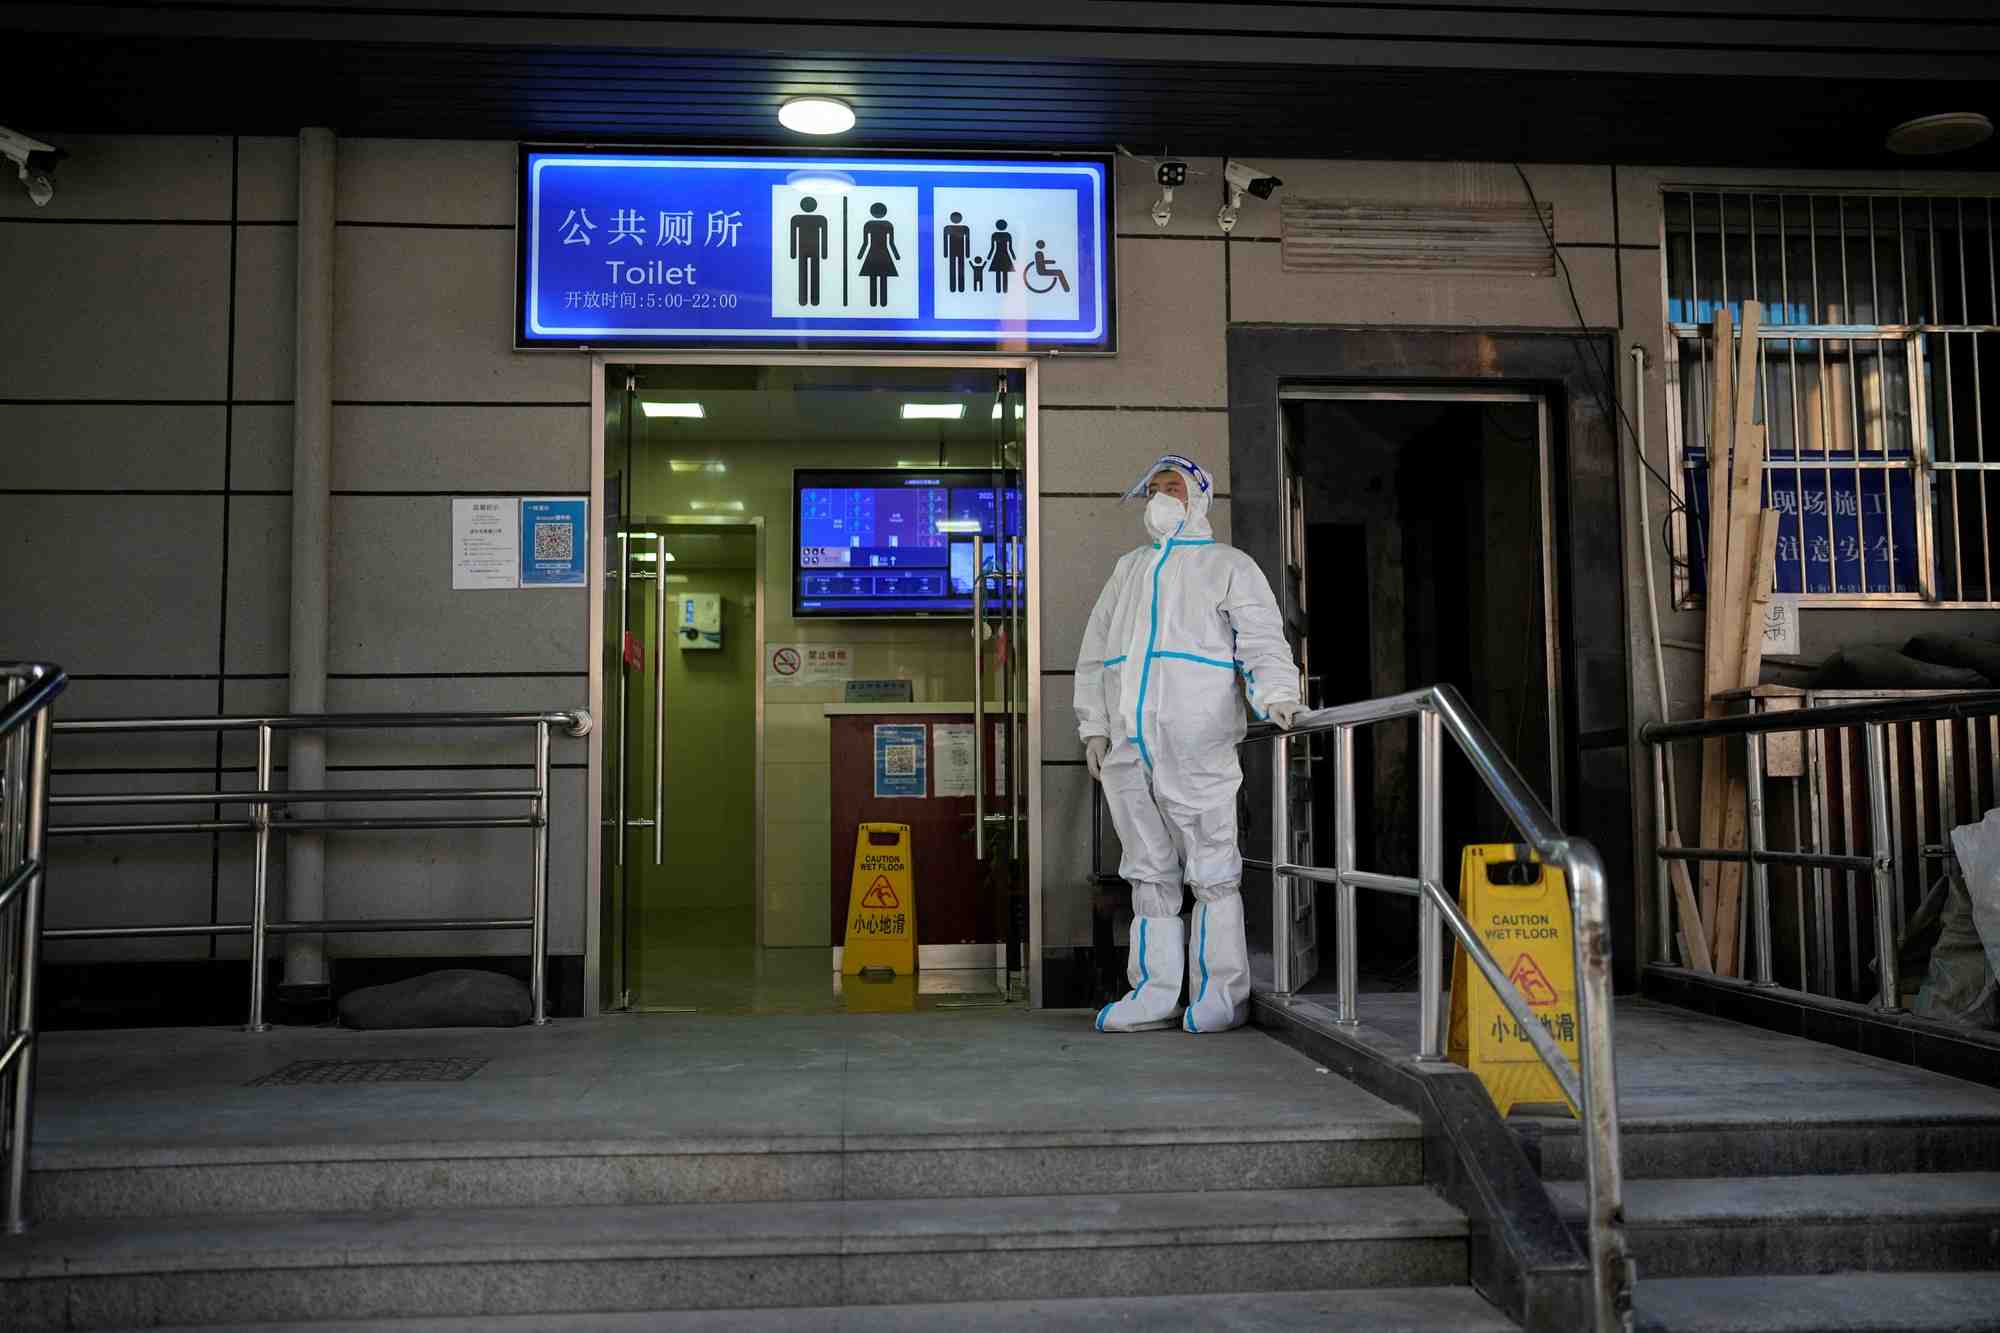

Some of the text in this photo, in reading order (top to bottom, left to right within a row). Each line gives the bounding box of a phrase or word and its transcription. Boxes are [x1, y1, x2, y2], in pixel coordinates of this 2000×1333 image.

[558, 207, 743, 248] 公共厕所
[605, 260, 697, 285] Toilet
[1773, 490, 1892, 516] 现场施工
[1777, 535, 1899, 562] 注意安全
[861, 863, 905, 871] WET FLOOR
[865, 855, 901, 863] CAUTION
[854, 913, 905, 935] 小心地滑
[1492, 914, 1549, 925] CAUTION
[1484, 928, 1559, 940] WET FLOOR
